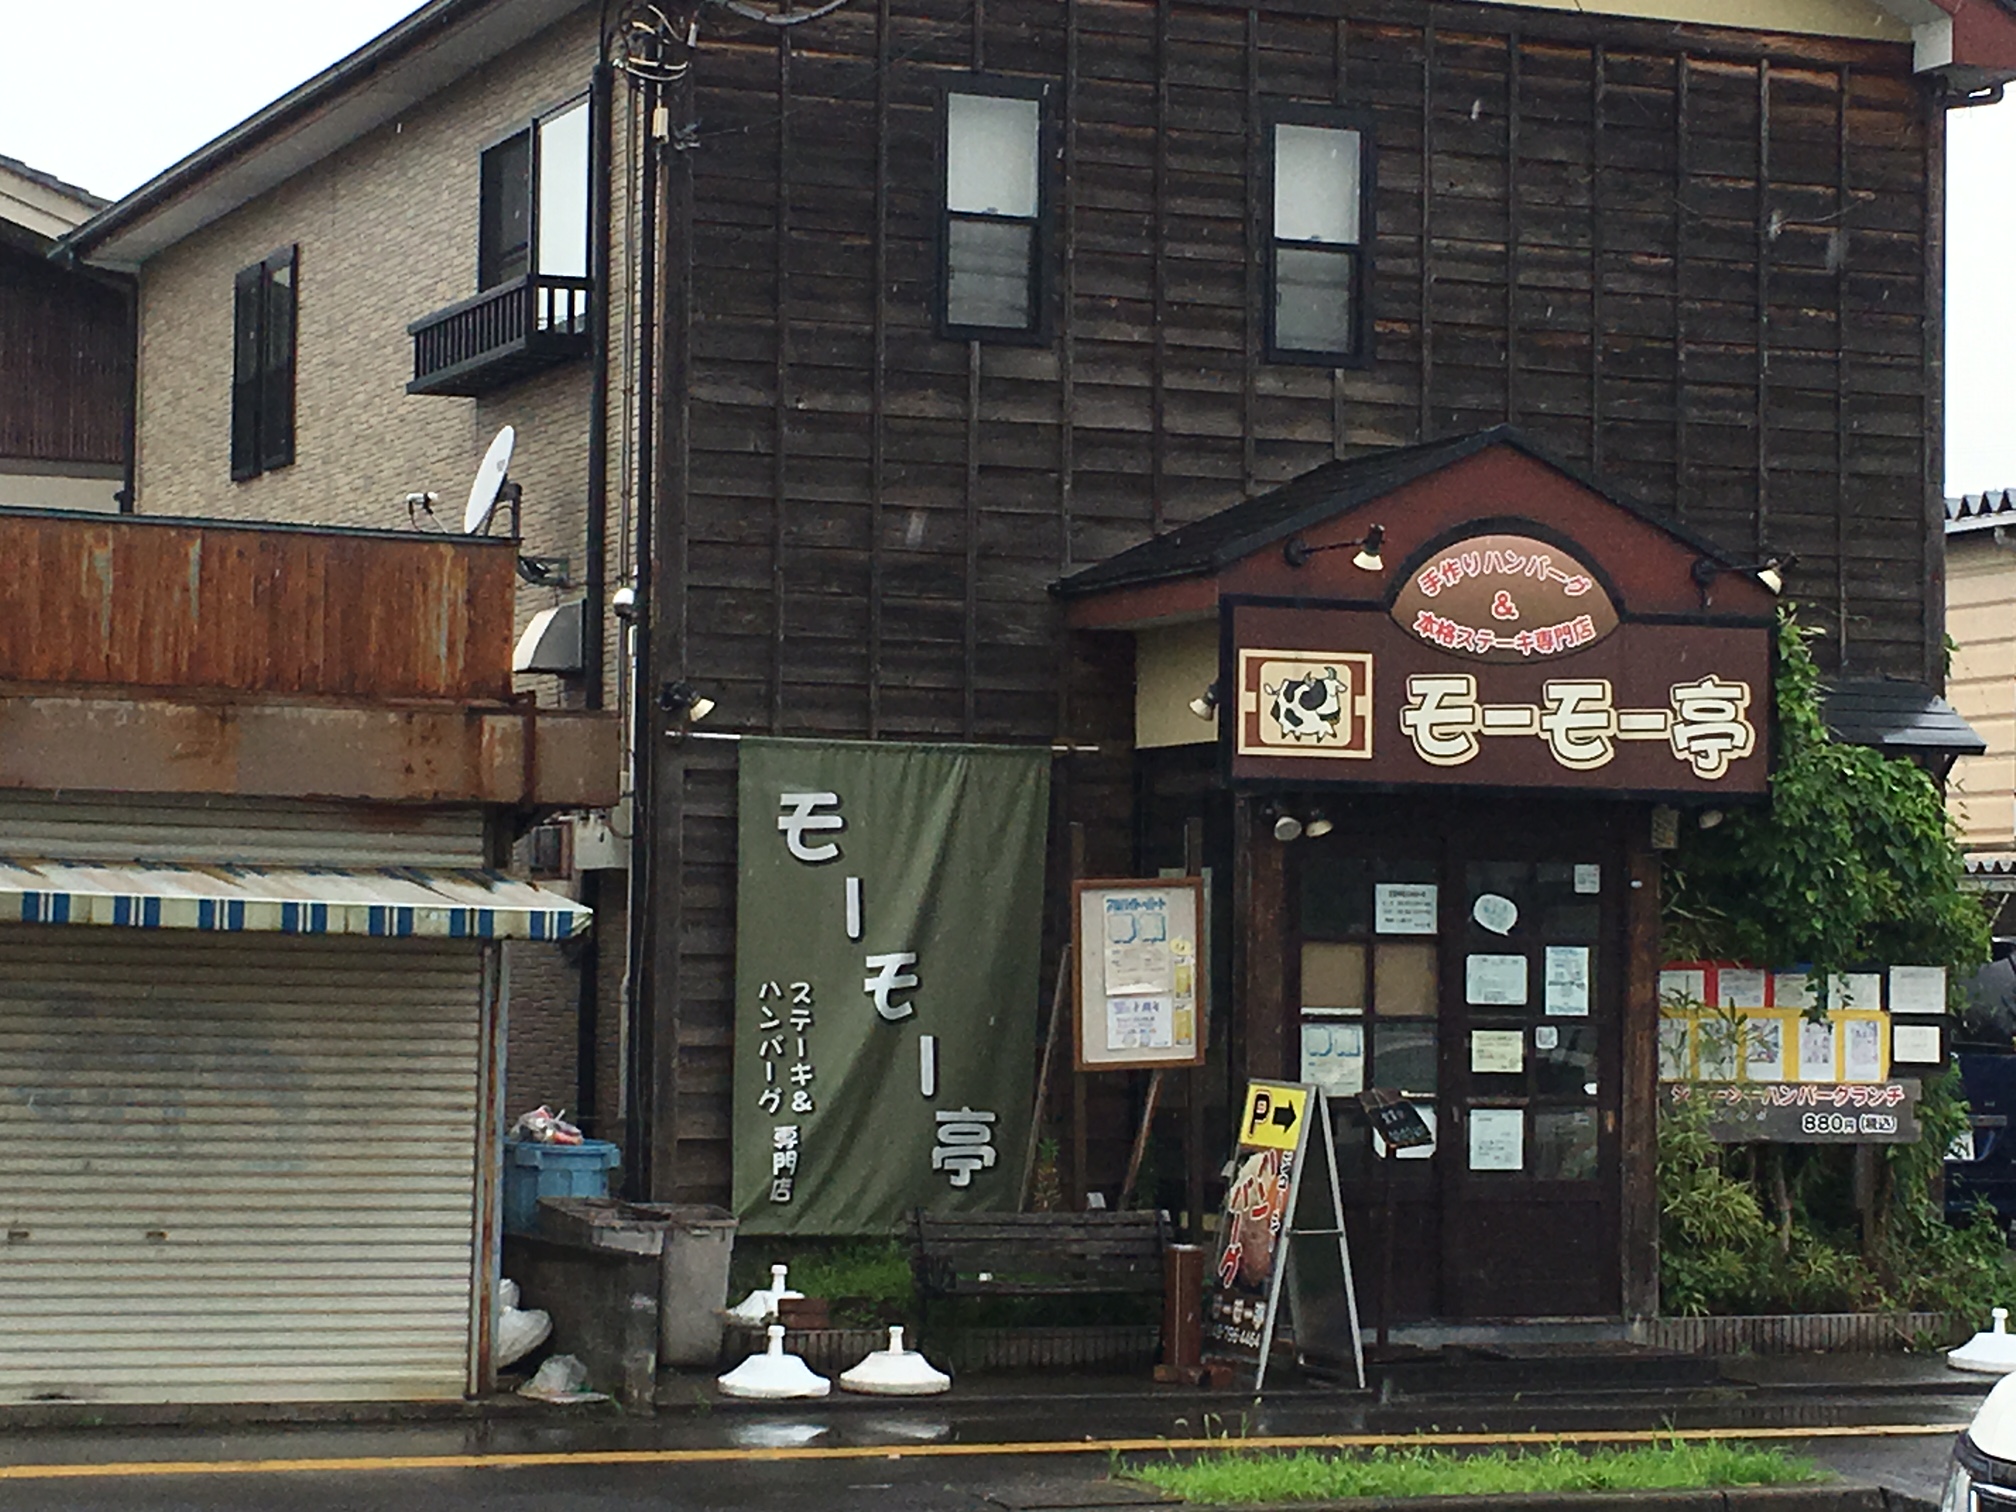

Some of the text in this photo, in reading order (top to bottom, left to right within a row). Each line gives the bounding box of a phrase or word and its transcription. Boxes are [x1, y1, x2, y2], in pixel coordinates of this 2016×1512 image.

[1418, 550, 1592, 597] 手作りハンバーグ
[1492, 590, 1519, 620] &
[1413, 610, 1597, 656] 本格ステーキ専門店
[1402, 674, 1755, 780] モーモー亭
[777, 791, 996, 1187] モーモー亭
[758, 981, 784, 1114] ハンバーグ
[789, 981, 813, 1113] ステーキ&
[1247, 1090, 1271, 1138] P
[769, 1125, 799, 1203] 専門店
